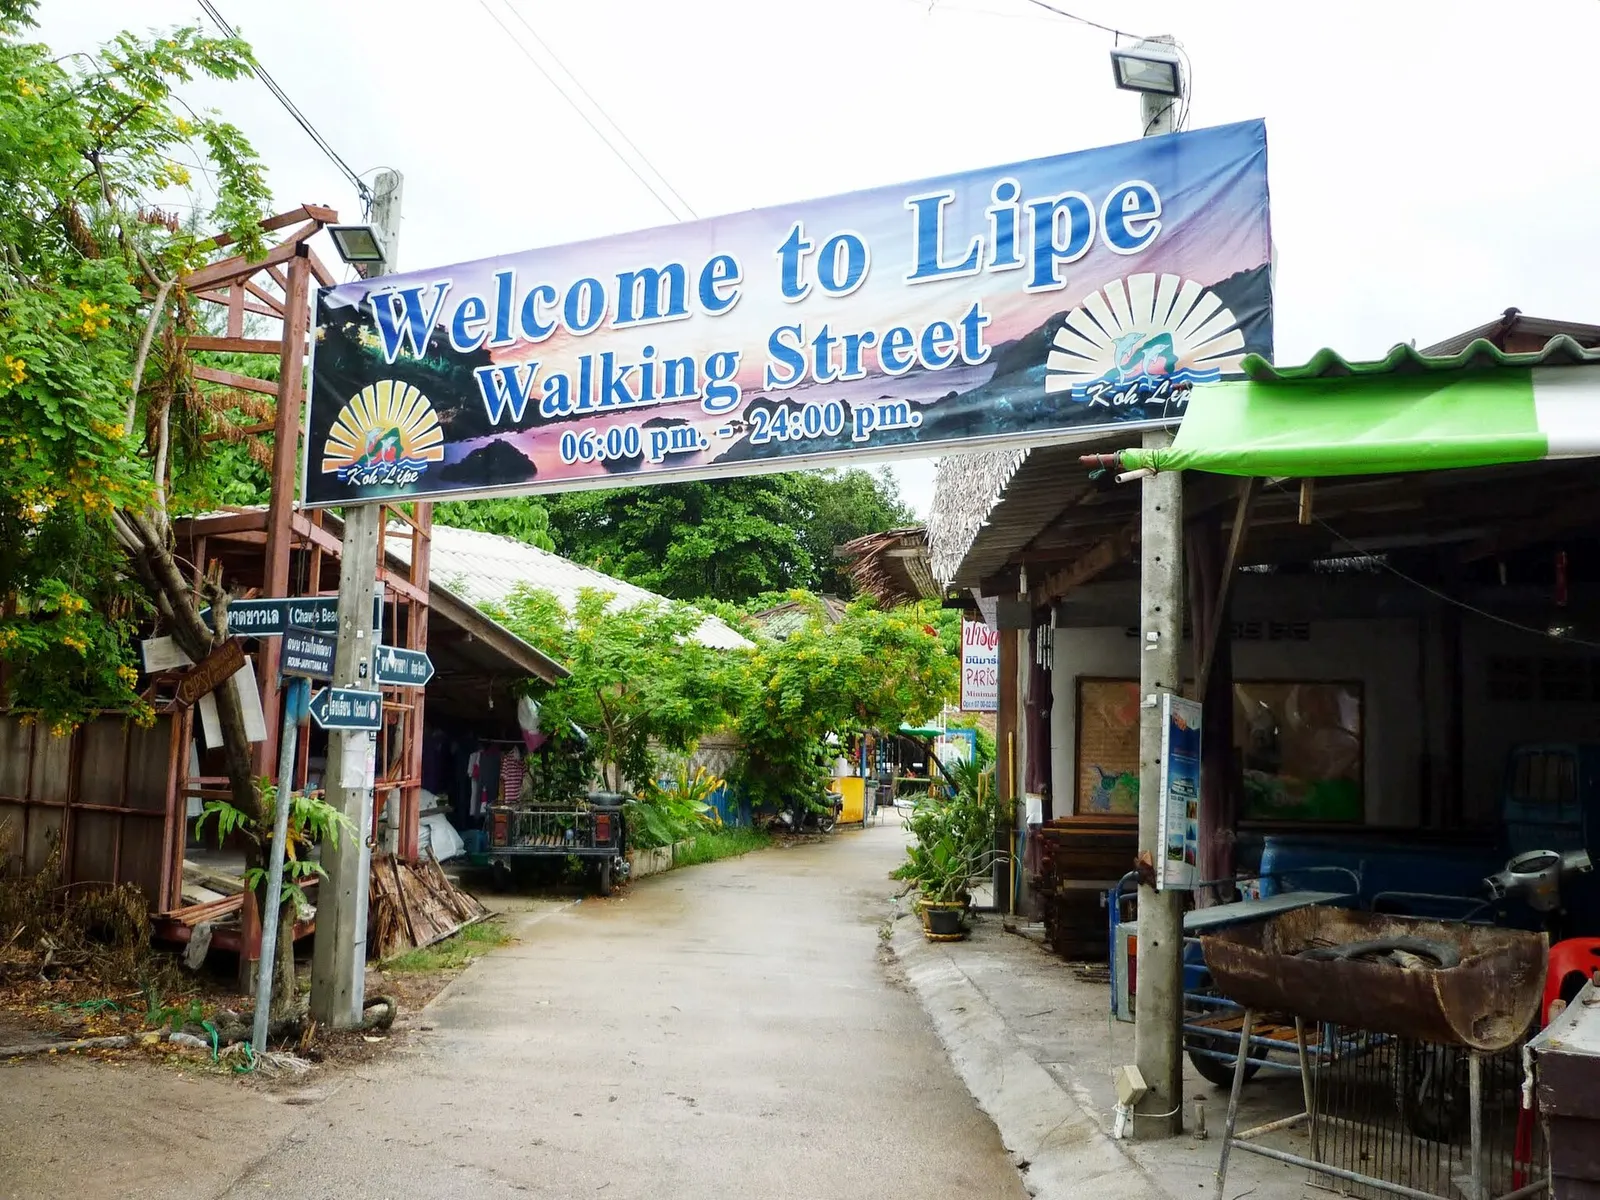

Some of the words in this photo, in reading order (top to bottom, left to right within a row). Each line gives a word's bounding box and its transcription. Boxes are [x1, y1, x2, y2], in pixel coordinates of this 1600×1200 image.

[370, 252, 741, 364] Welcome
[775, 221, 870, 303] to
[905, 178, 1161, 293] Lipe
[476, 344, 743, 425] Walking
[764, 301, 993, 391] Street
[1087, 384, 1138, 407] Koh
[1145, 379, 1191, 407] Lip
[560, 424, 643, 464] 06:00
[650, 425, 710, 463] pm.
[749, 401, 844, 444] 24:00
[852, 399, 922, 442] pm.
[347, 467, 378, 485] Koh
[381, 466, 419, 487] Lipe
